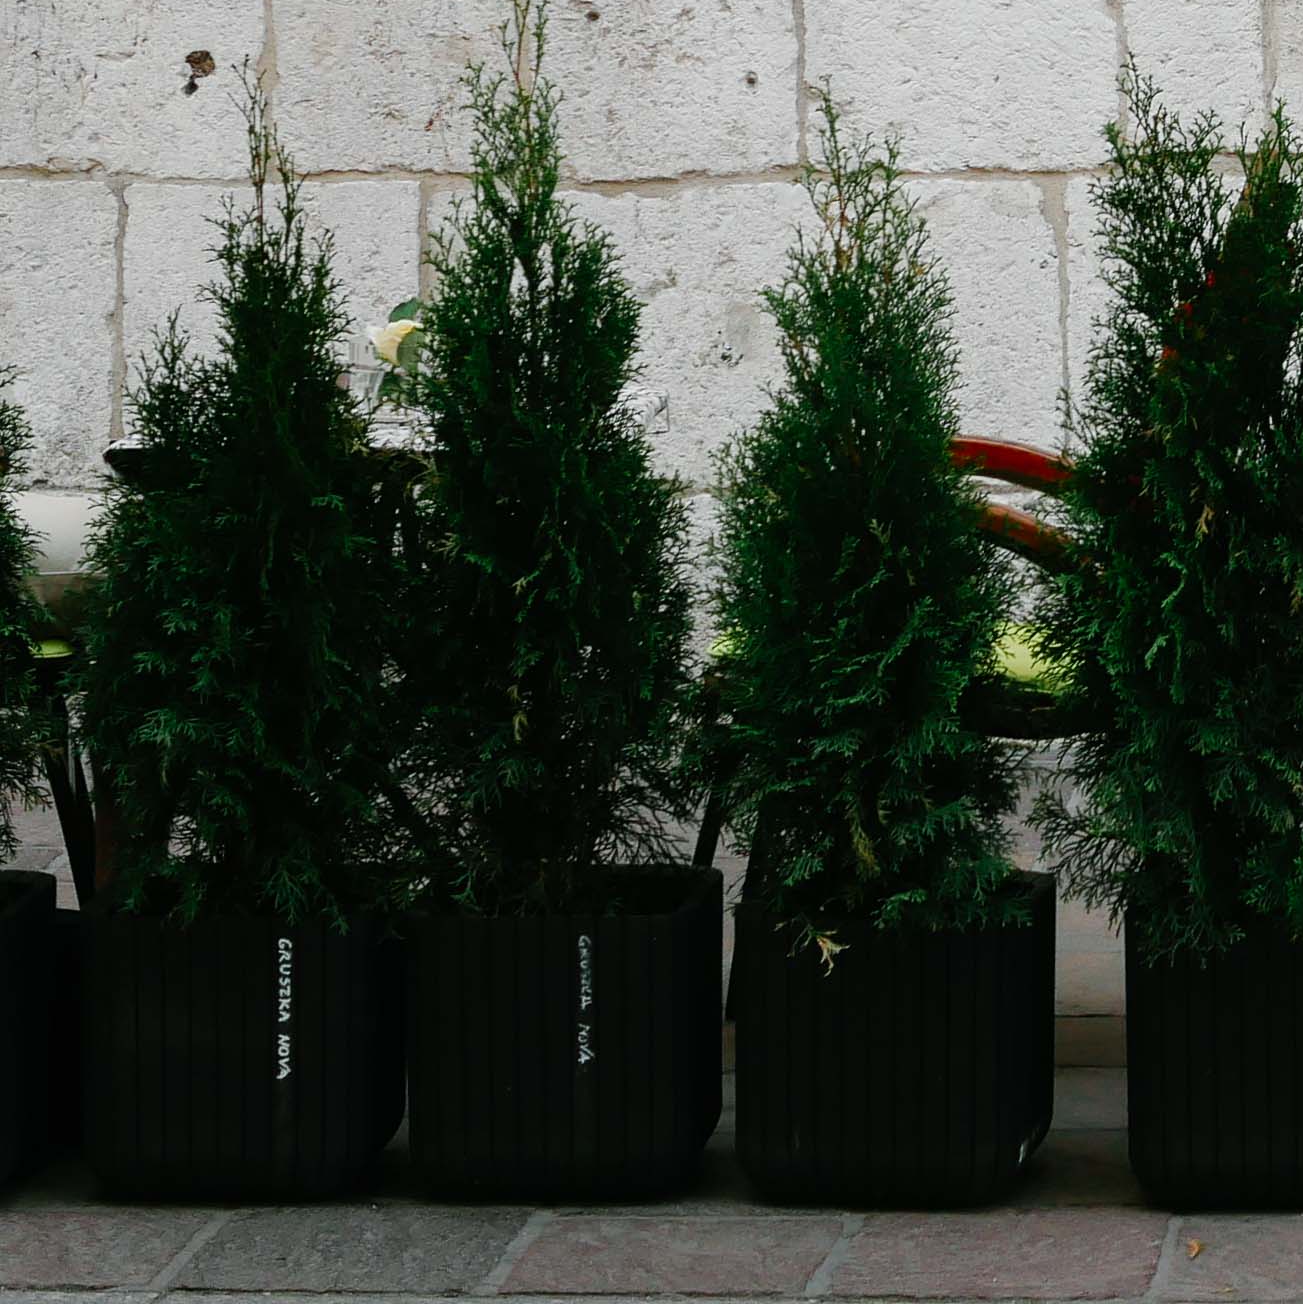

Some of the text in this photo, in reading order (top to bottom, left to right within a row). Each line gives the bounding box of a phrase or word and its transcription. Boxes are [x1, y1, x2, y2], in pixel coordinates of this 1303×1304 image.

[276, 937, 292, 1080] GRUSZKA NOVA
[577, 1023, 595, 1065] NOVA
